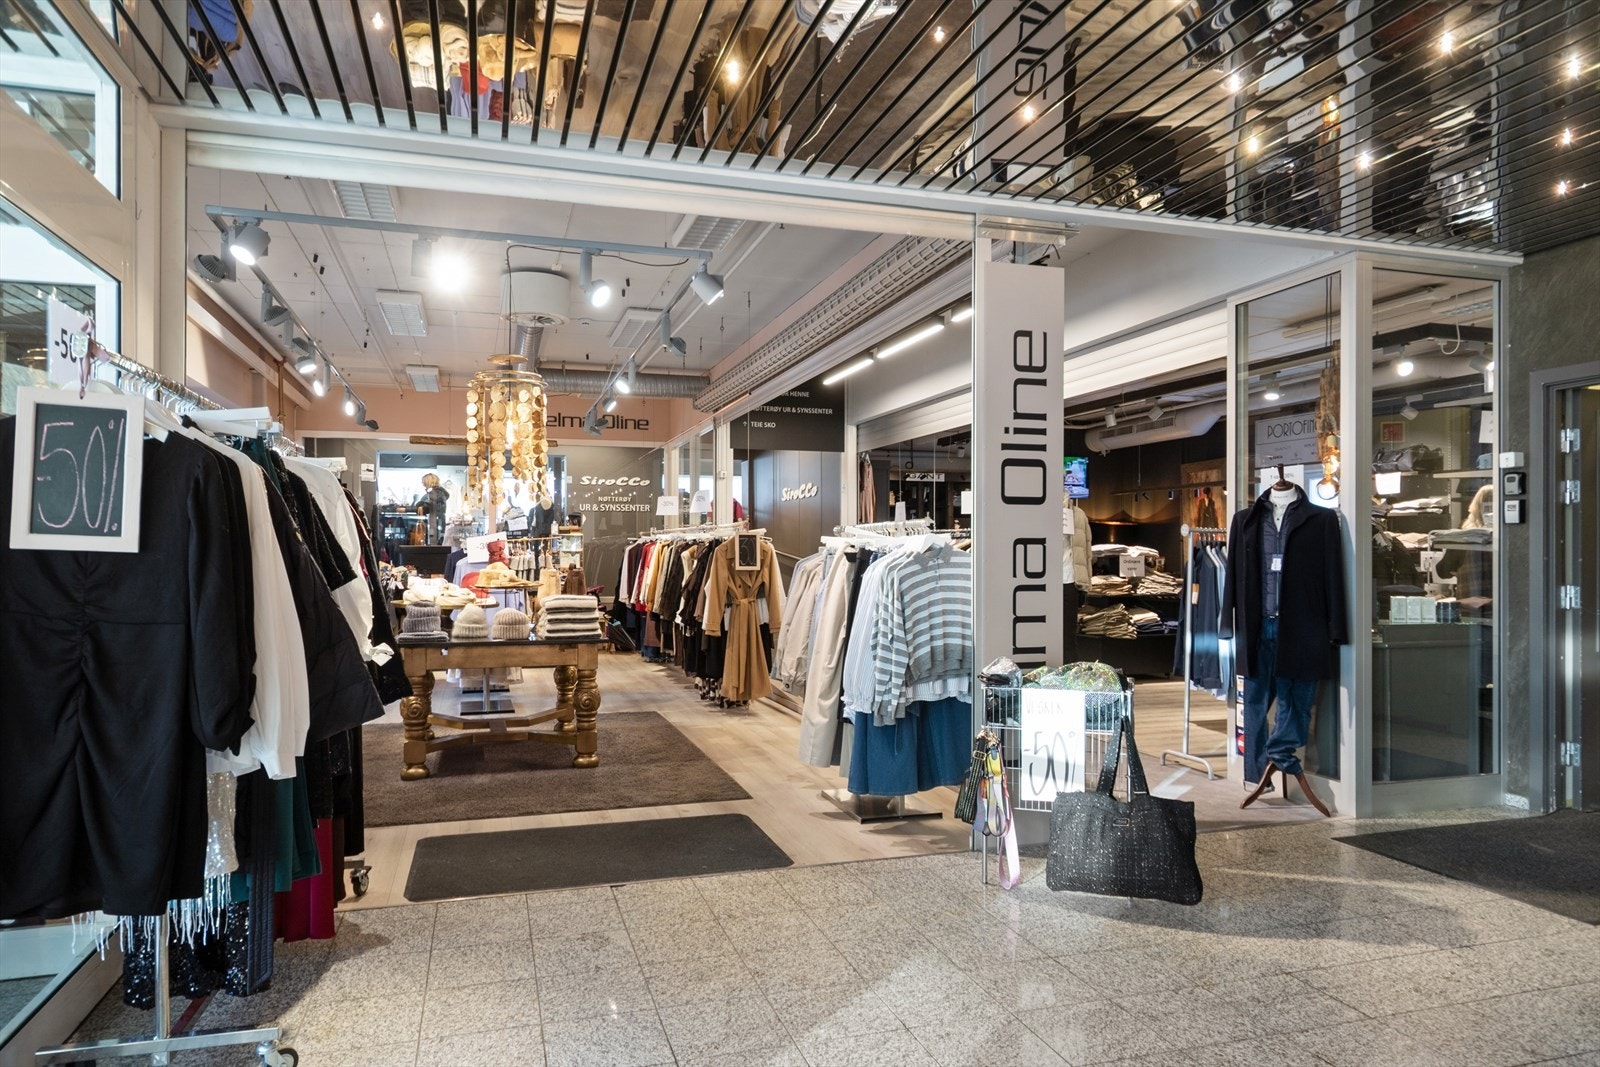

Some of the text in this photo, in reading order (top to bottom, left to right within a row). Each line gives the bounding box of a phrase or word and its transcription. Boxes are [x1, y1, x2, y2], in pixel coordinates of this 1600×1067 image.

[1000, 329, 1048, 505] Oline
[1267, 420, 1317, 438] PORTOFIN
[600, 504, 650, 512] SYNSSENTER
